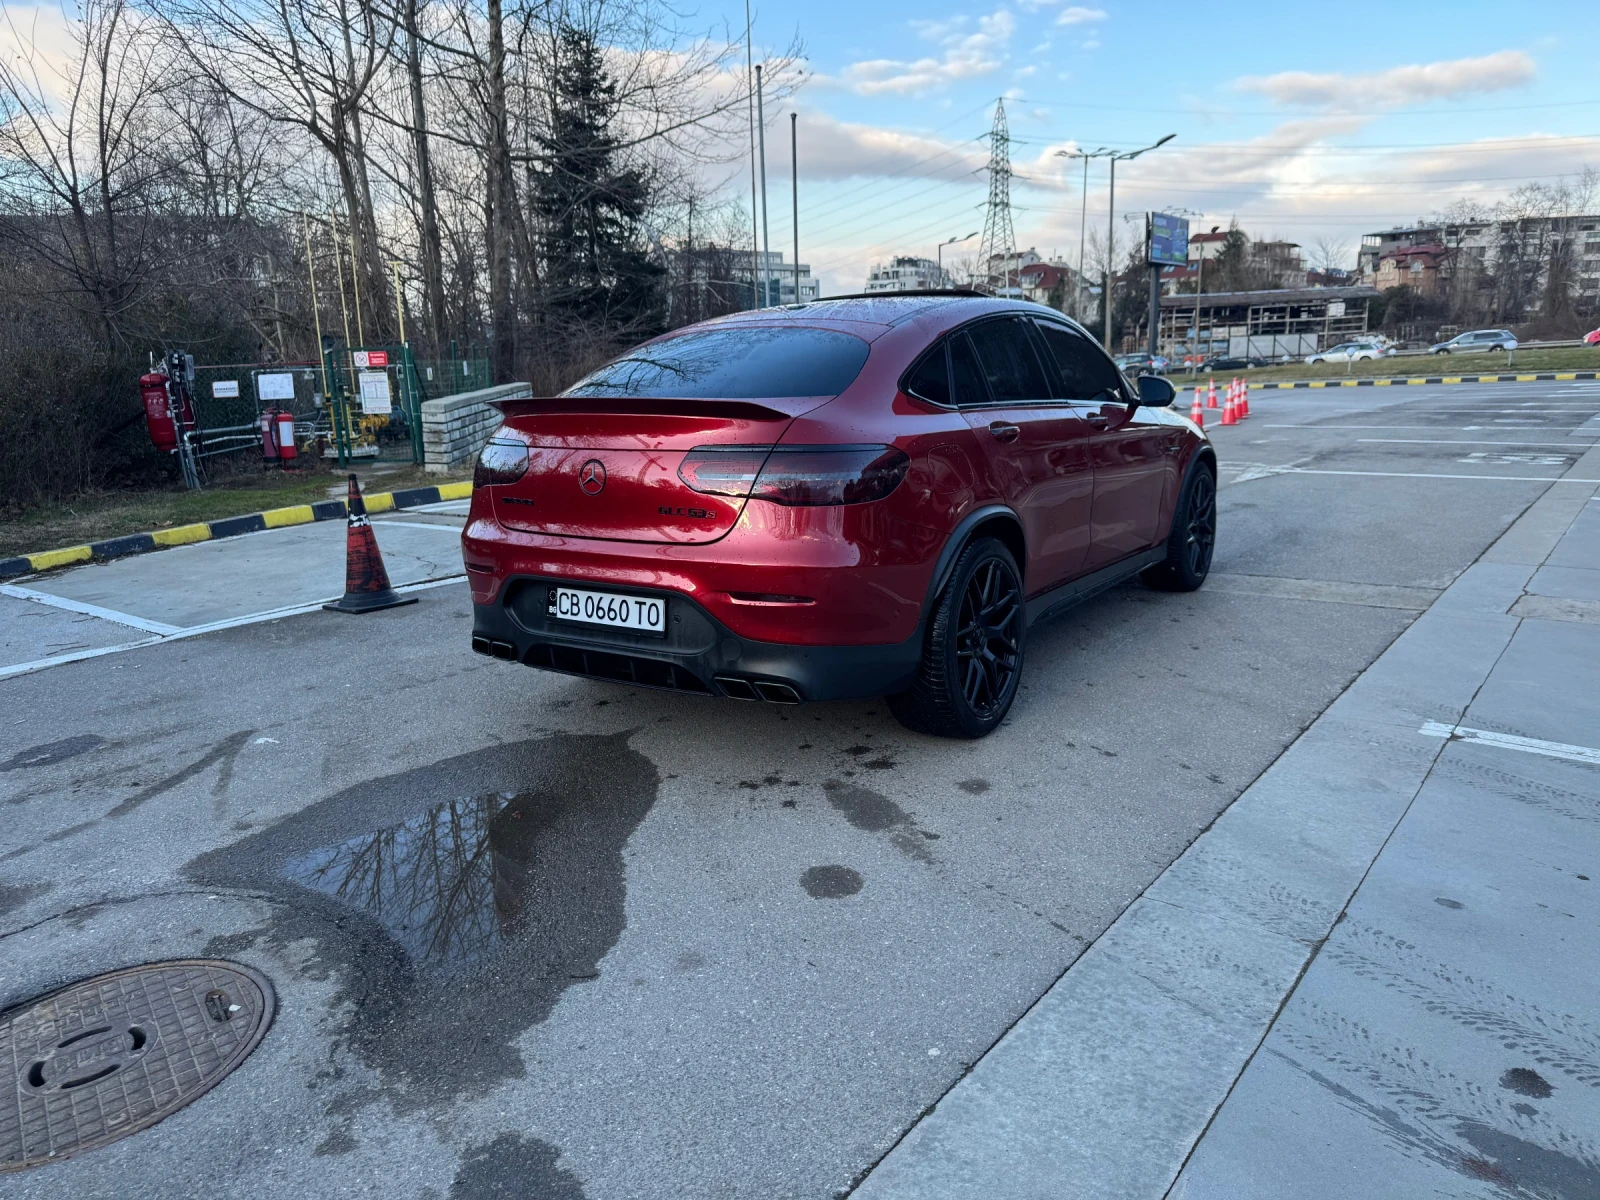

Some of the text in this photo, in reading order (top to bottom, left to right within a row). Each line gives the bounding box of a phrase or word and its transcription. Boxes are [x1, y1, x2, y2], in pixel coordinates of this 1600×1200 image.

[658, 506, 687, 516] GLC
[548, 605, 557, 613] BG
[559, 592, 580, 616] CB
[585, 595, 630, 622] 0660
